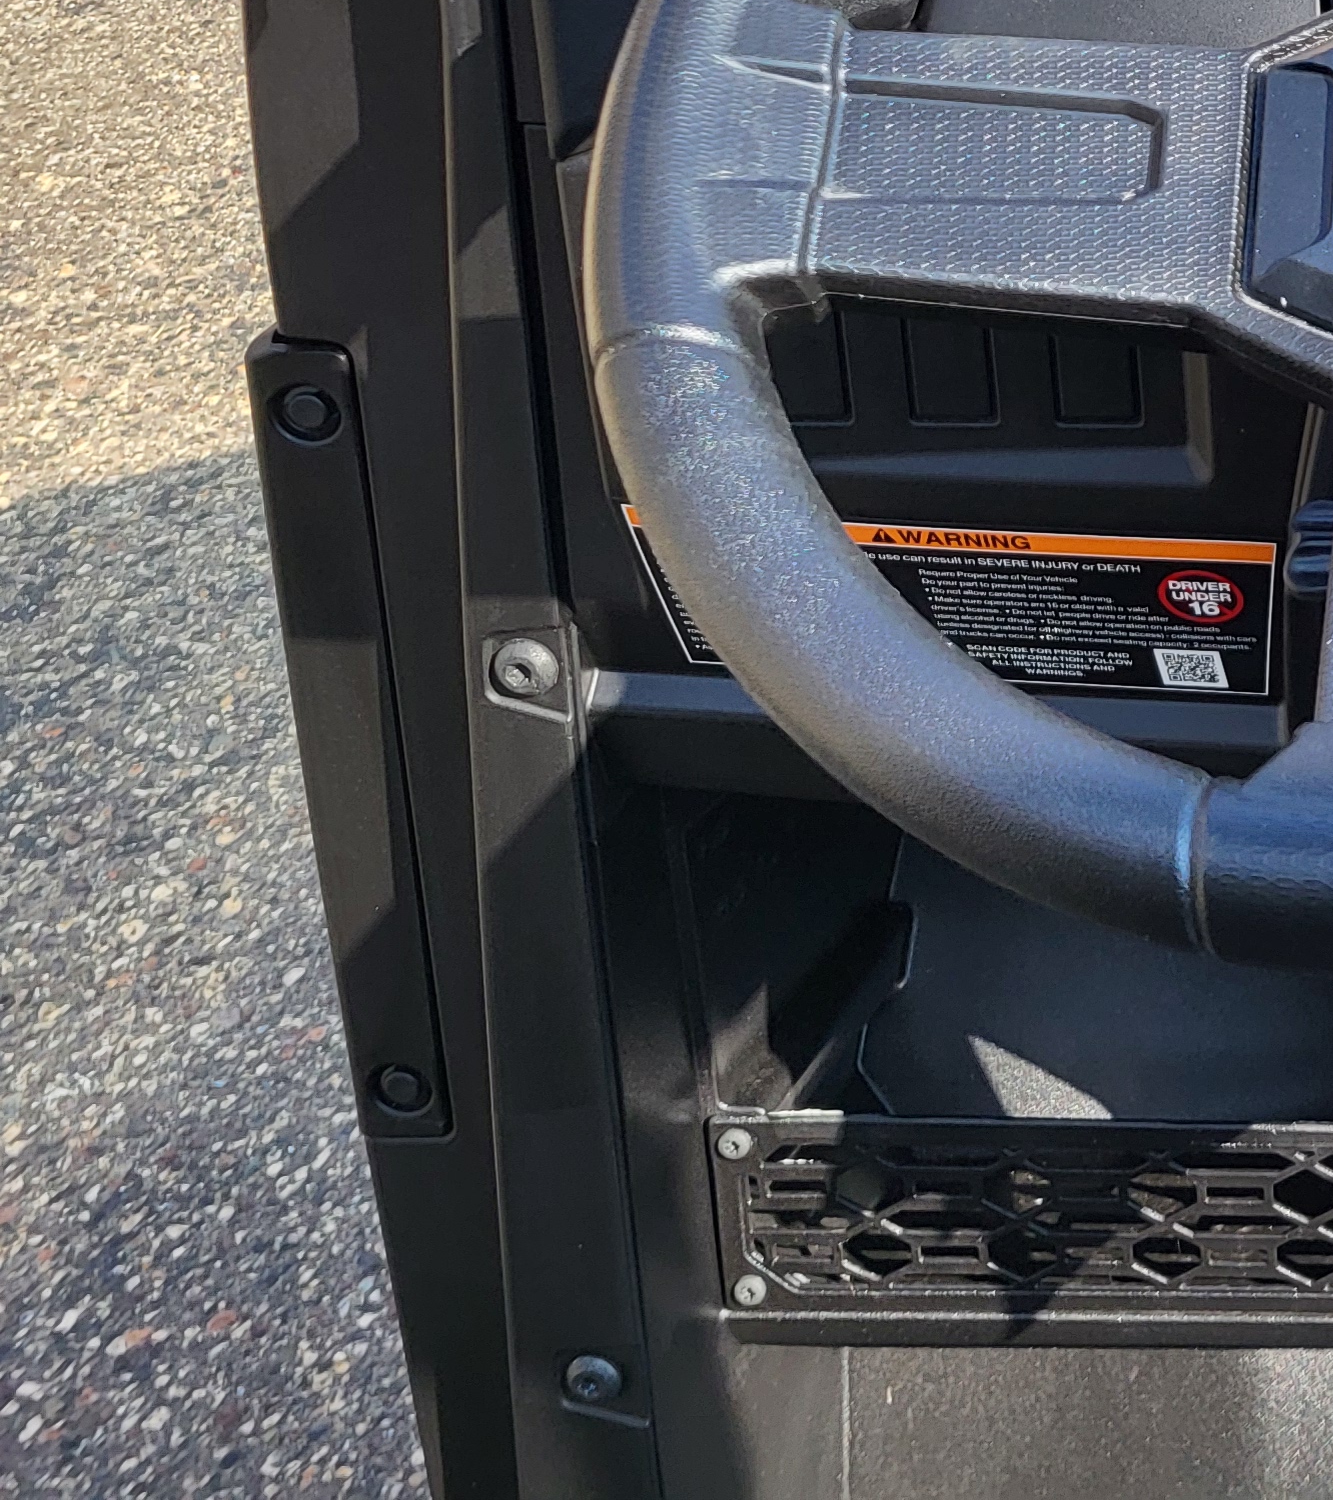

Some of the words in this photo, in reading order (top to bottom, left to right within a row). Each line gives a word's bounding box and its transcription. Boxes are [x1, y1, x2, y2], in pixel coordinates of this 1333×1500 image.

[897, 529, 1032, 550] WARNING
[879, 553, 900, 561] use
[902, 555, 926, 563] can
[927, 556, 963, 565] result
[965, 557, 976, 565] in
[977, 557, 1030, 569] SEVERE
[1032, 560, 1080, 571] INJURY
[1082, 564, 1095, 572] or
[1096, 563, 1141, 573] DEATH
[918, 568, 956, 578] Require
[957, 570, 989, 580] Proper
[1021, 574, 1043, 582] Your
[1043, 575, 1079, 583] Vehicle
[921, 577, 936, 586] Do
[937, 579, 957, 587] your
[960, 581, 979, 589] part
[991, 582, 1027, 591] prevent
[1167, 580, 1231, 592] DRIVER
[1171, 591, 1232, 603] UNDER
[1188, 601, 1221, 616] 16
[965, 644, 997, 652] SCAN
[997, 645, 1029, 654] CODE
[1029, 647, 1053, 655] FOR
[1053, 647, 1105, 657] PRODUCT
[967, 650, 1009, 660] SAFETY
[1092, 664, 1116, 673] AND
